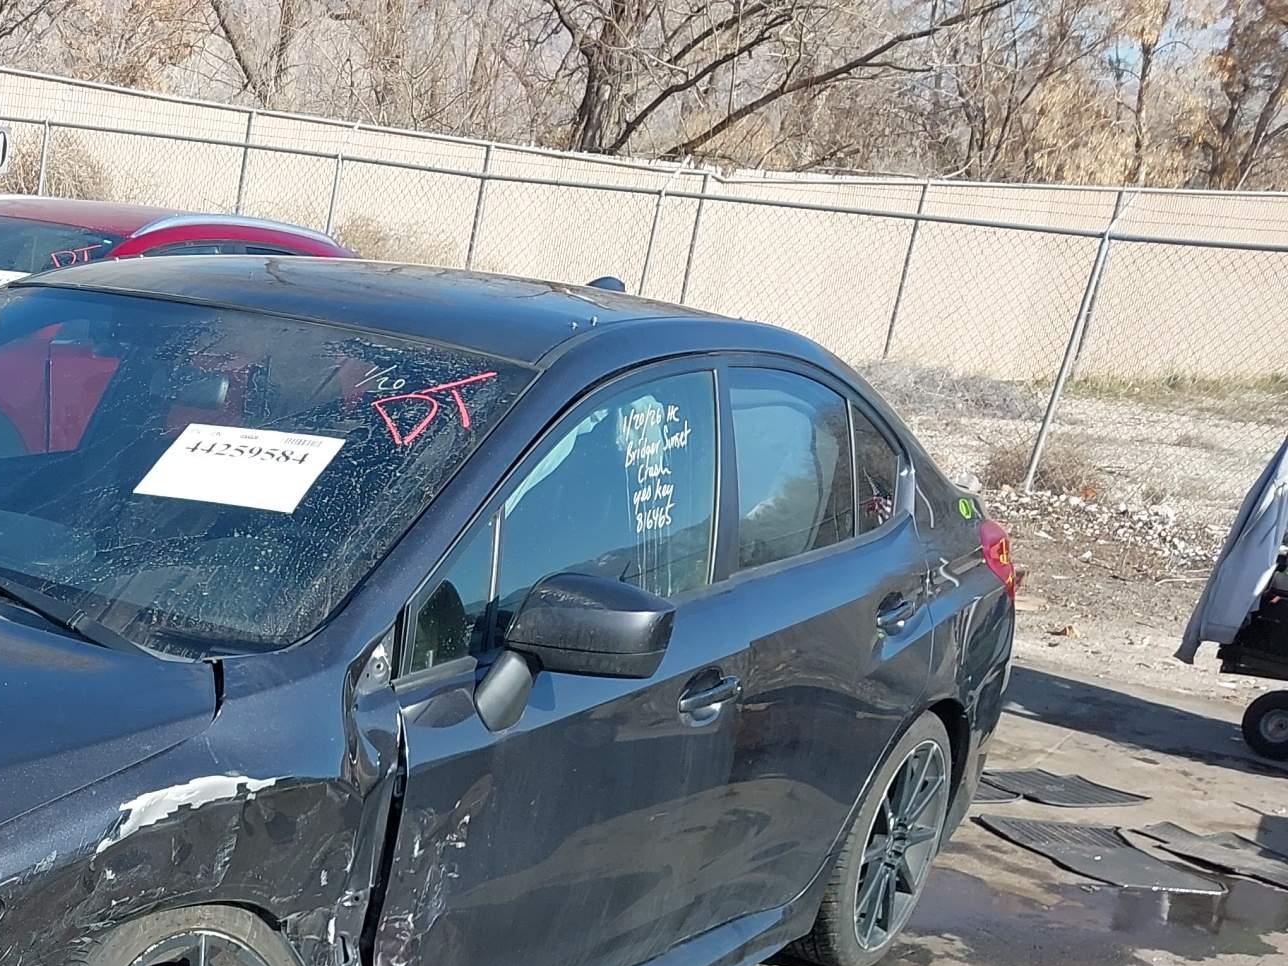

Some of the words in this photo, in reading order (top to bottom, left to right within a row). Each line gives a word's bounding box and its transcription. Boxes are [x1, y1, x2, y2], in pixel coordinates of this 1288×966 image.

[51, 244, 103, 268] DT
[370, 371, 498, 446] DT
[186, 440, 310, 465] 44259584
